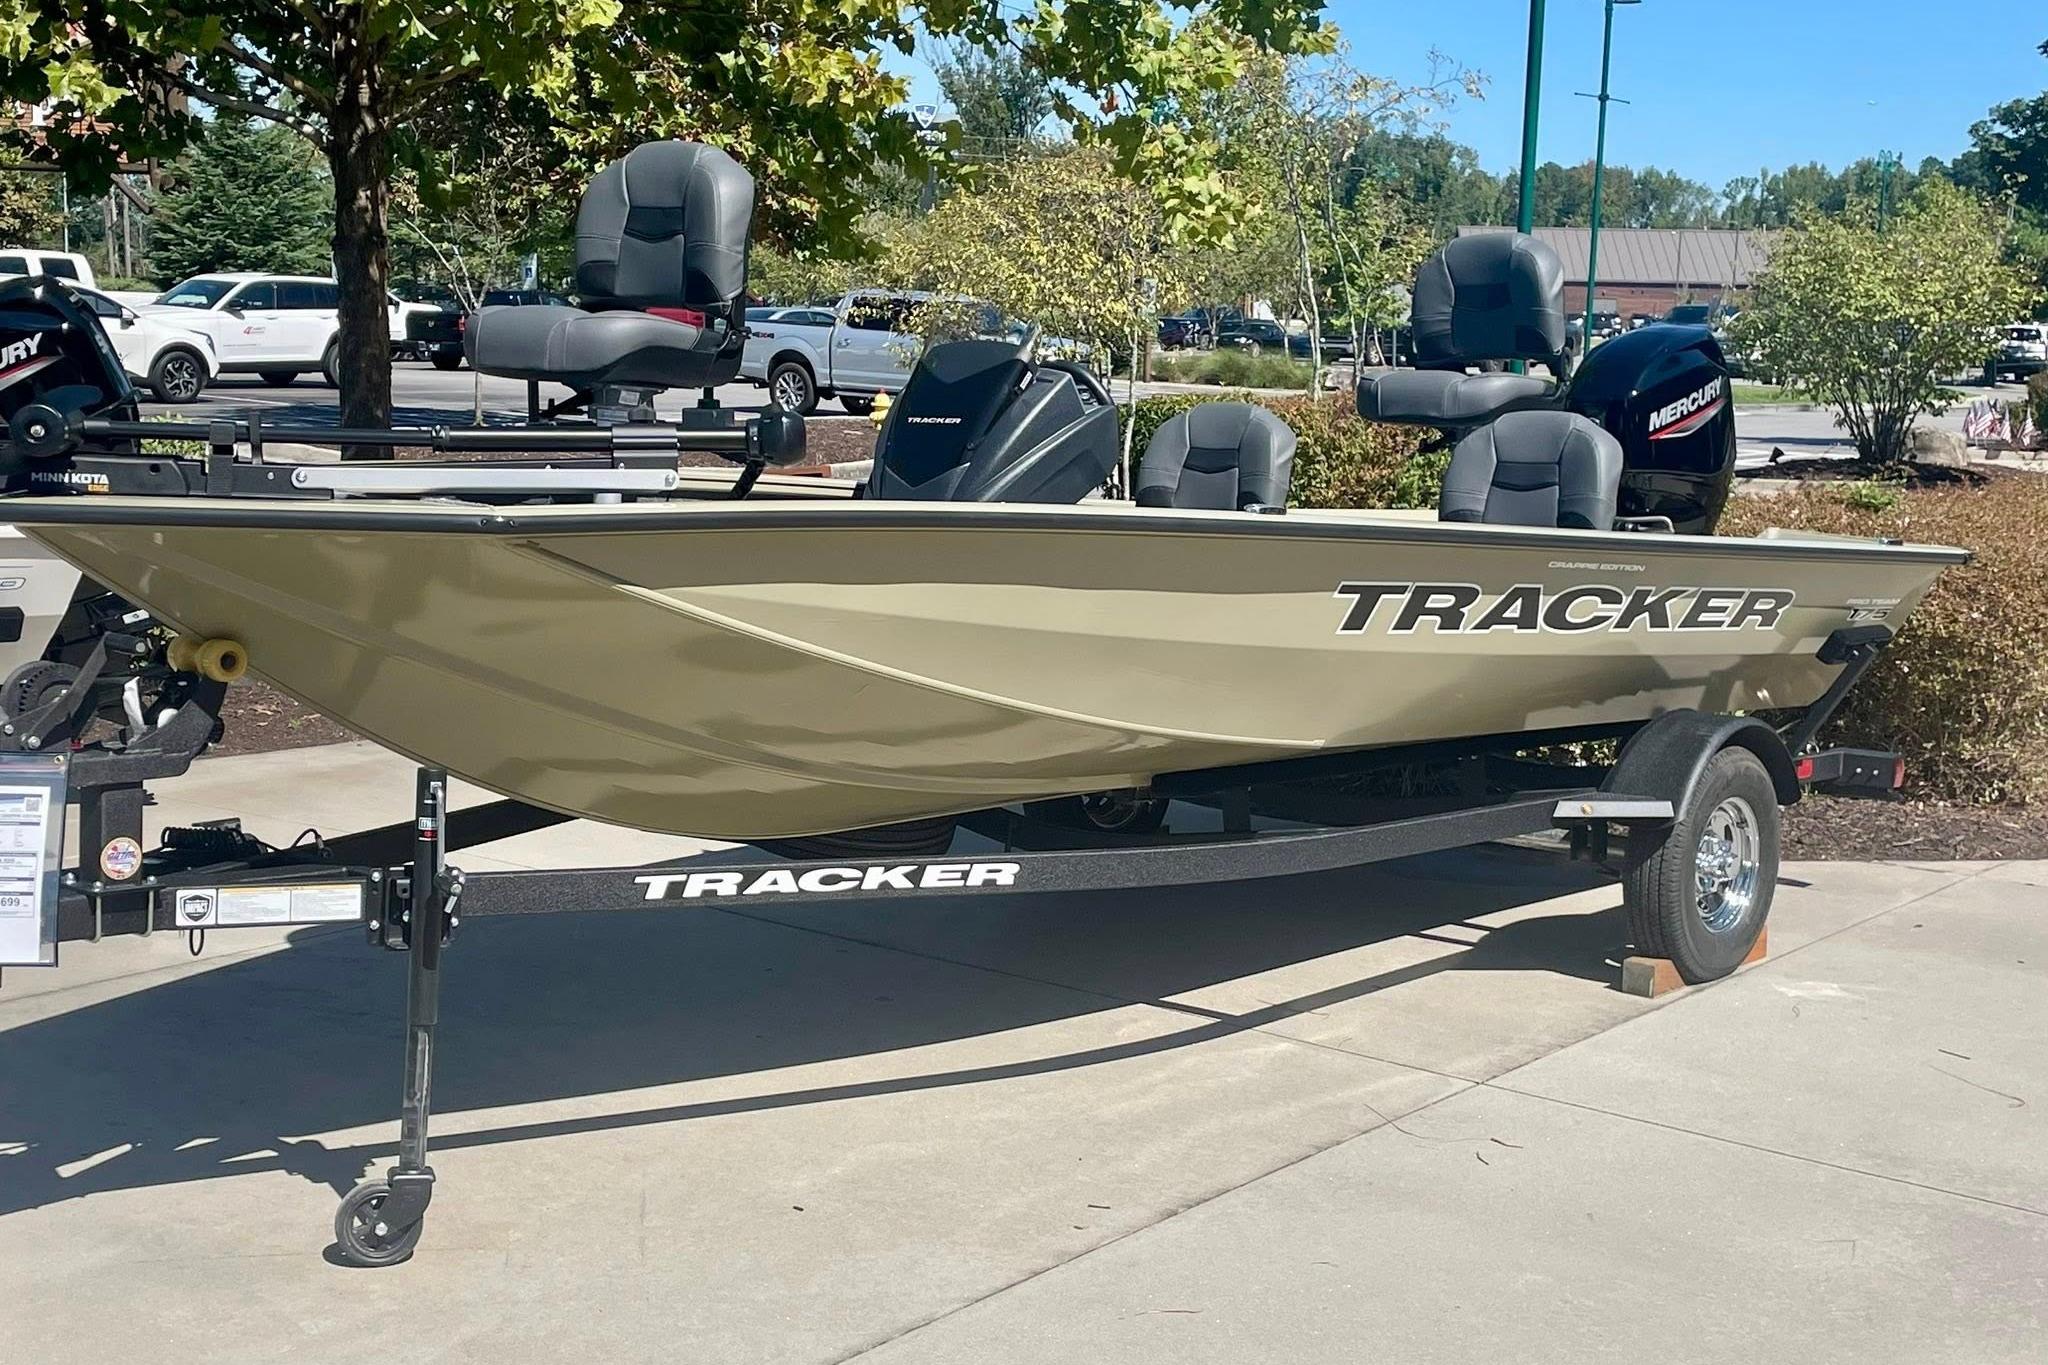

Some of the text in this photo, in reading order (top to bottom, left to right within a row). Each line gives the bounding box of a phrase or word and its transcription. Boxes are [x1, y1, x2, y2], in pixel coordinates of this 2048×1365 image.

[1648, 375, 1722, 432] MERCURY
[31, 472, 110, 484] MINN KOTA
[1548, 561, 1646, 572] CRAPPIE EDITION
[1333, 581, 1796, 635] TRACKER
[1846, 607, 1894, 621] 175
[633, 862, 1021, 900] TRACKER
